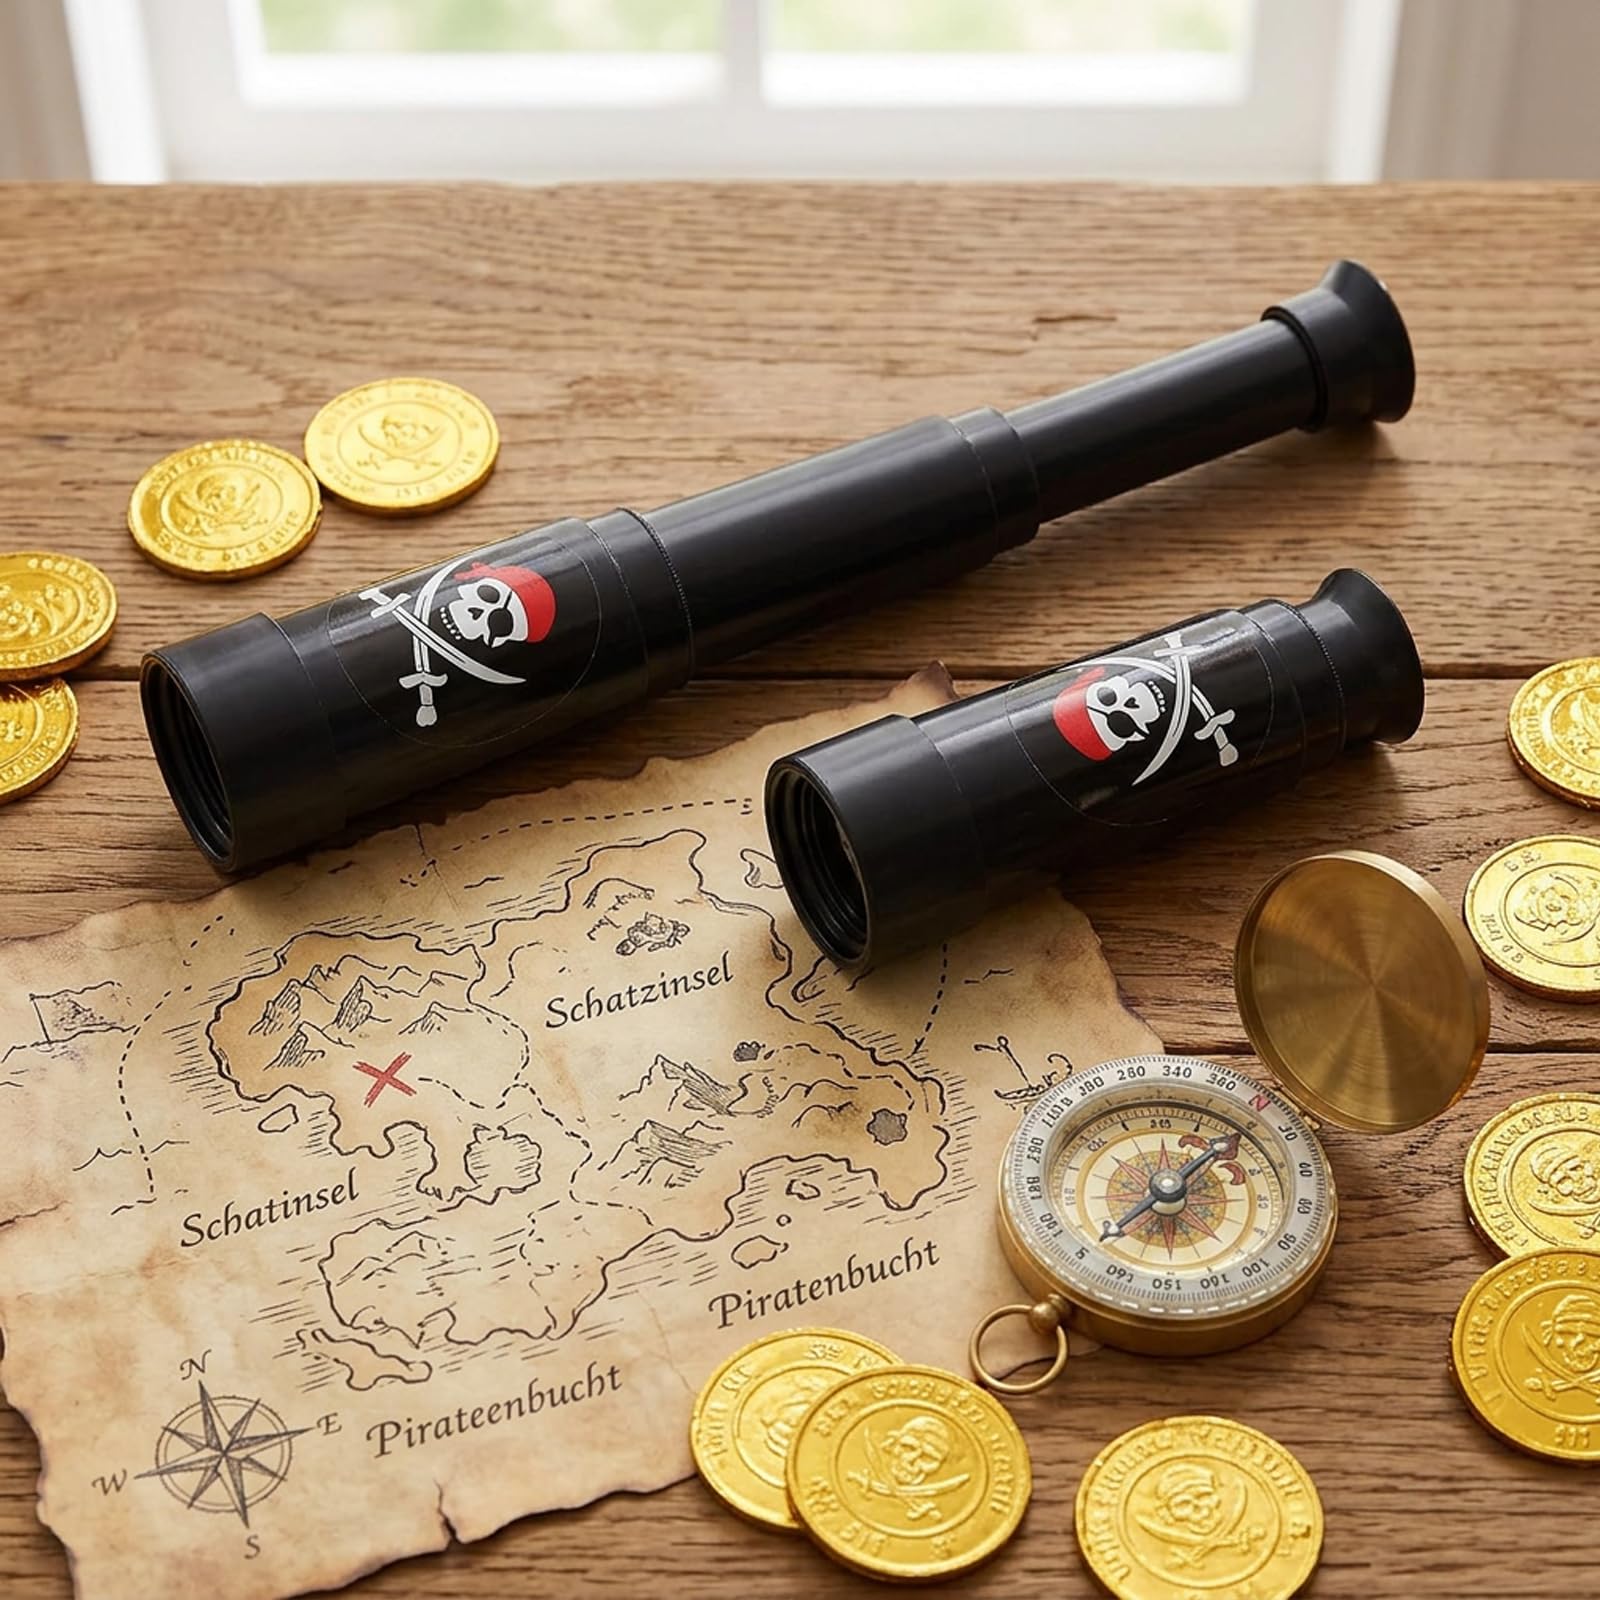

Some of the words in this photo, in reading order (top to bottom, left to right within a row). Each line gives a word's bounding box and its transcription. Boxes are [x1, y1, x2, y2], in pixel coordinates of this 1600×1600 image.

[545, 951, 734, 1029] Schatzinsel
[1116, 1065, 1146, 1081] 280
[1162, 1065, 1192, 1079] 340
[180, 1168, 360, 1248] Schatinsel
[709, 1237, 940, 1329] Piratenbucht
[1152, 1278, 1182, 1291] 150
[180, 1349, 212, 1381] N
[316, 1412, 342, 1436] E
[365, 1361, 624, 1460] Pirateenbucht
[91, 1468, 128, 1496] W
[244, 1534, 261, 1560] S
